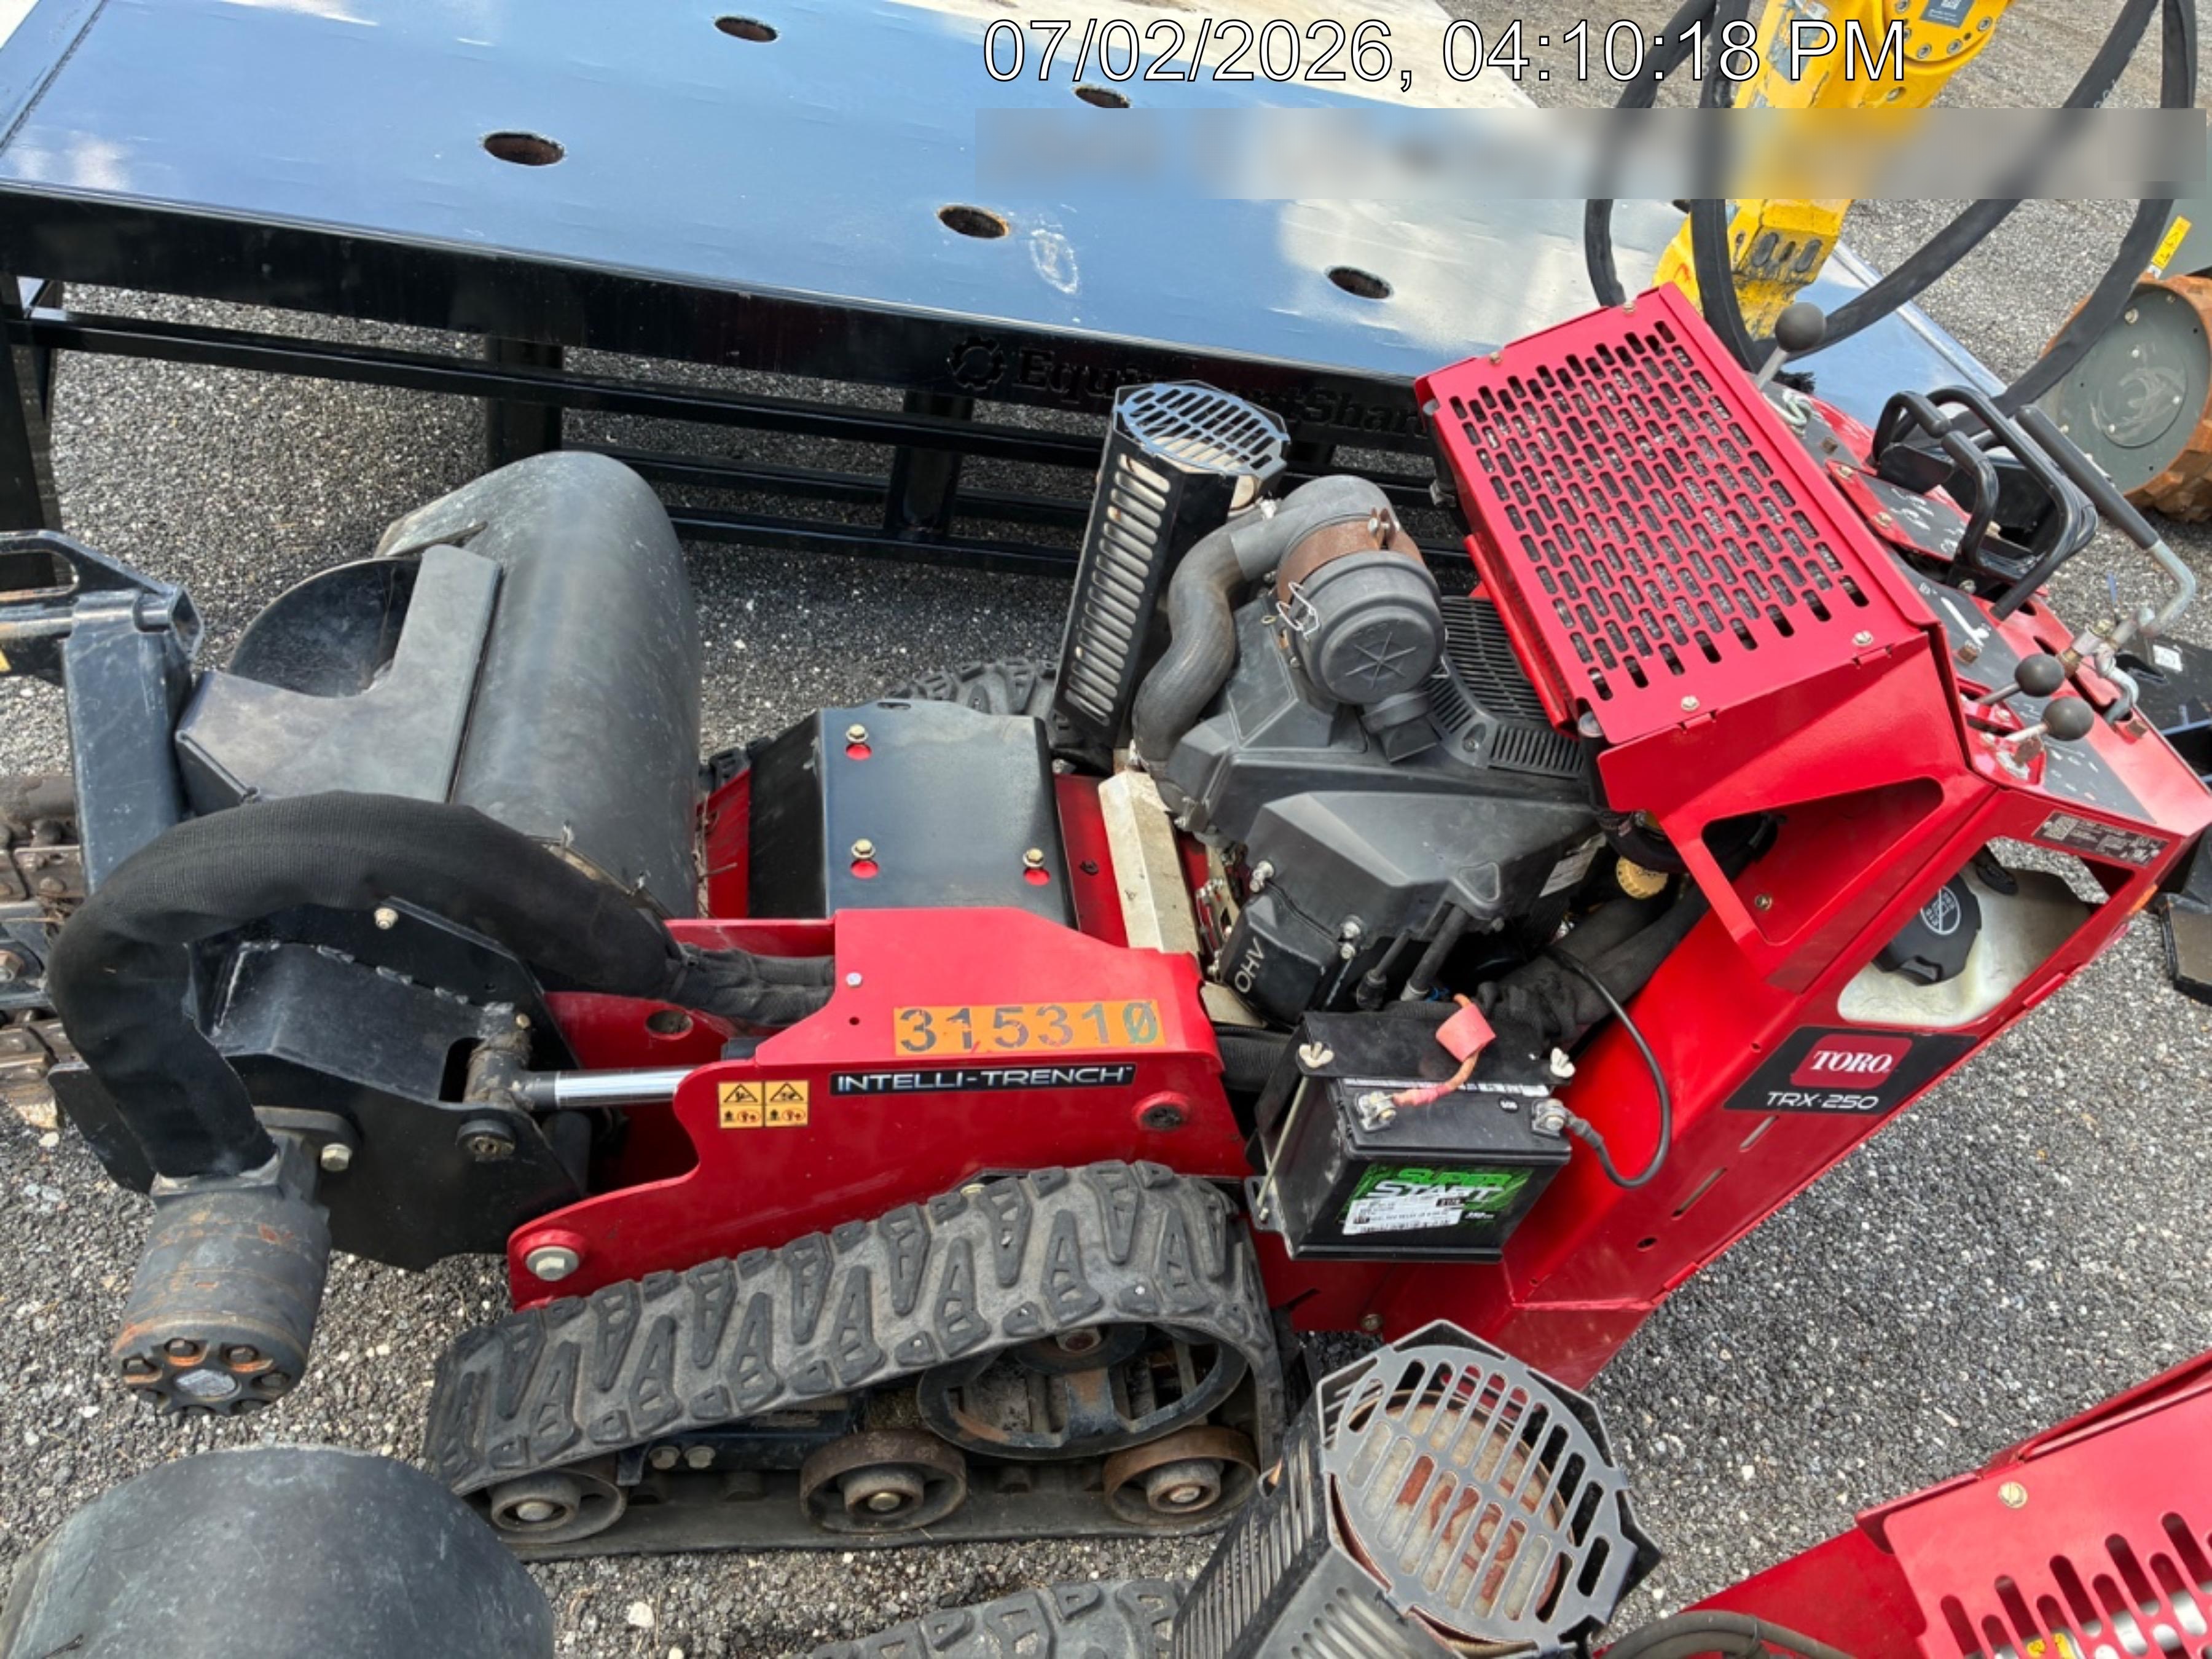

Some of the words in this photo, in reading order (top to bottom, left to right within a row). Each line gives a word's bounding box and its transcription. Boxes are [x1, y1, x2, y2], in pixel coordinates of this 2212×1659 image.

[1234, 936, 1264, 994] OHV
[900, 1000, 1159, 1053] 315310
[1810, 1050, 1892, 1073] TORO
[1397, 1168, 1512, 1186] SUPER
[1366, 1180, 1504, 1202] START
